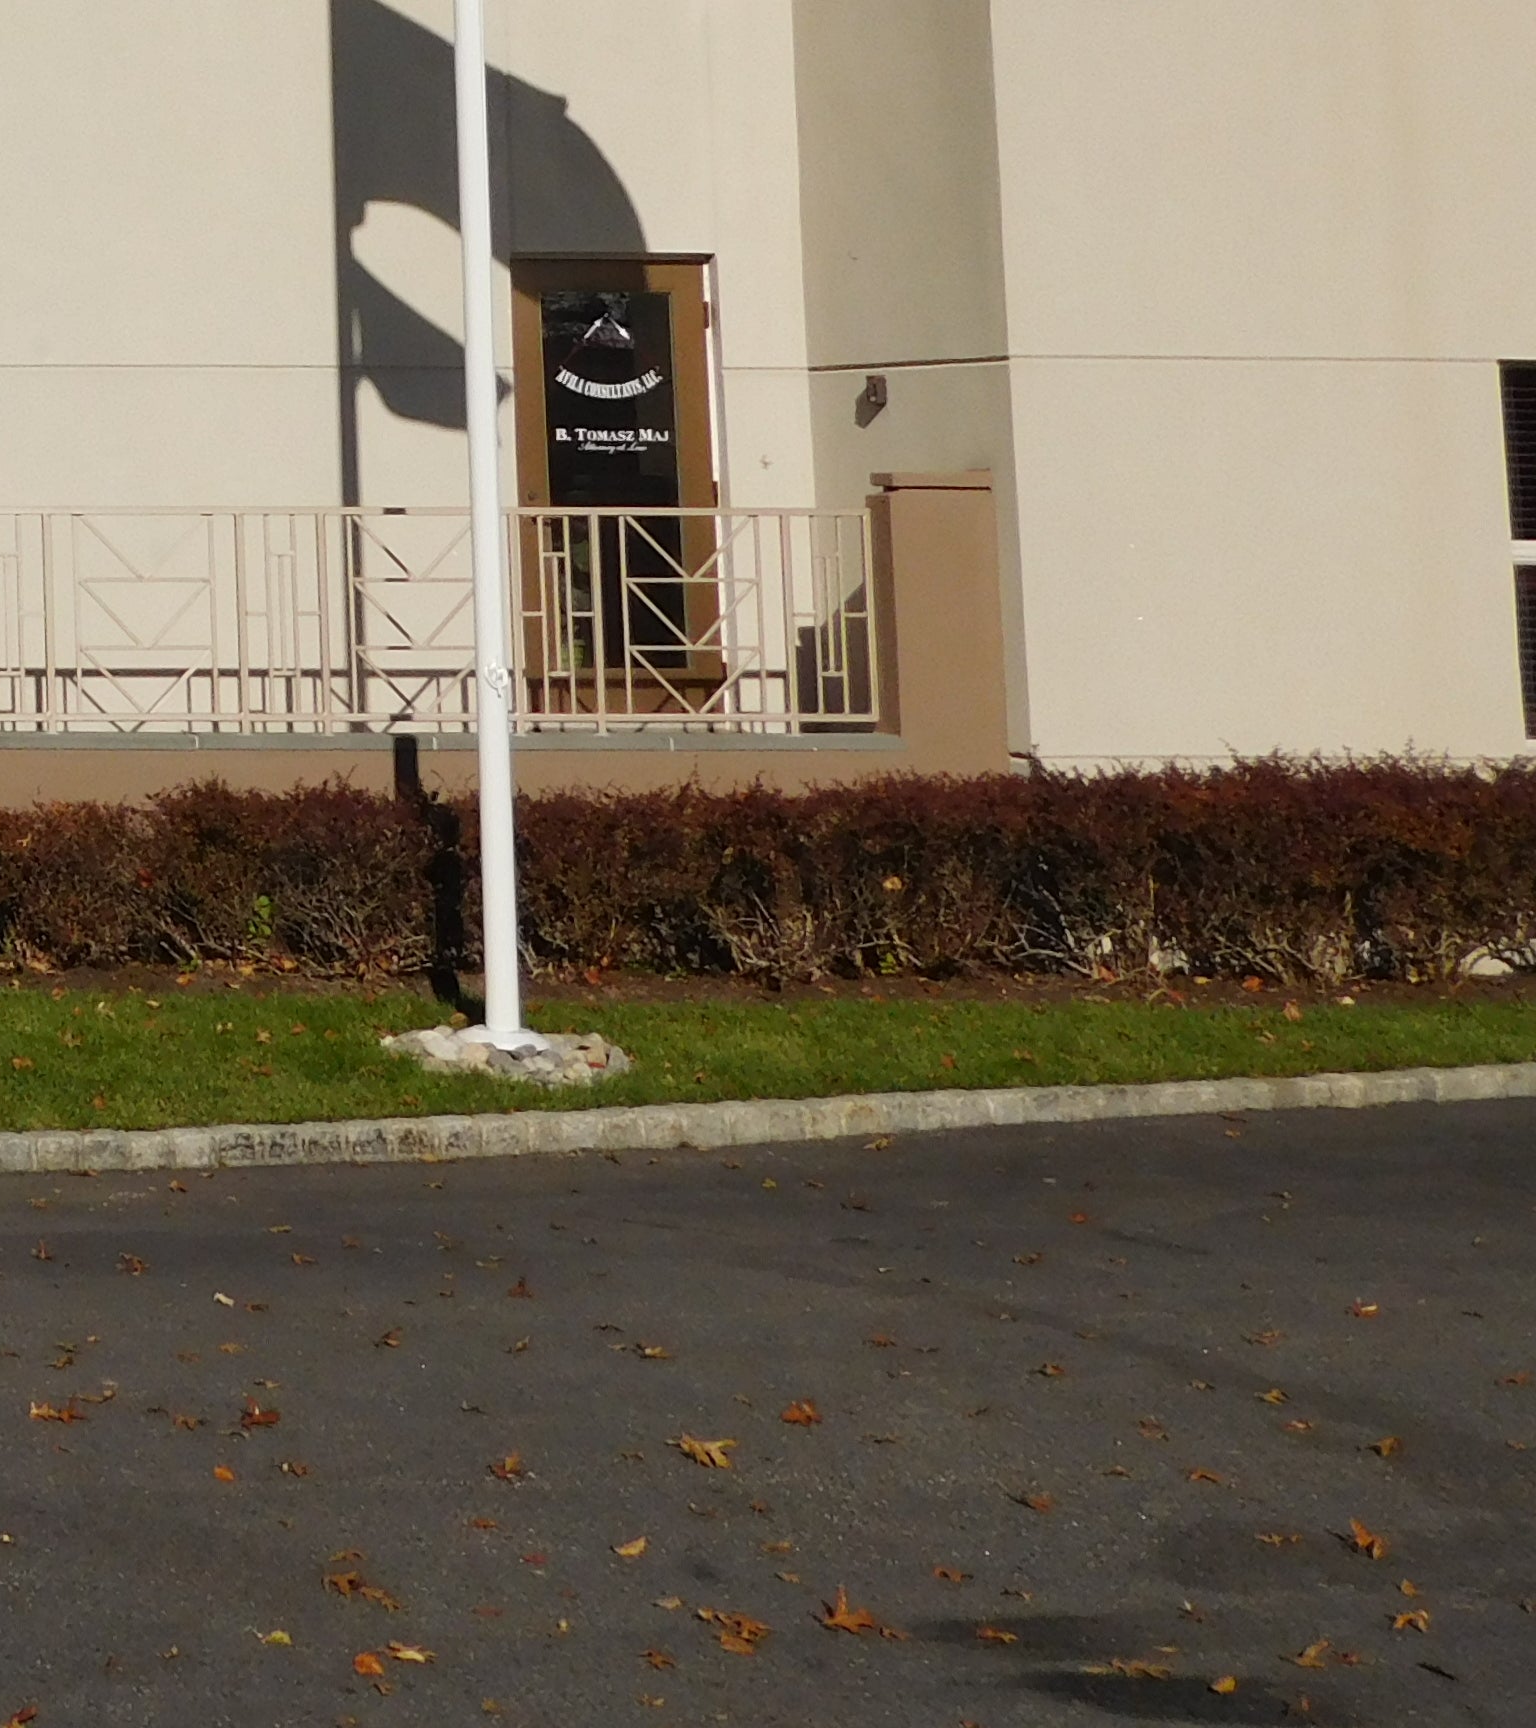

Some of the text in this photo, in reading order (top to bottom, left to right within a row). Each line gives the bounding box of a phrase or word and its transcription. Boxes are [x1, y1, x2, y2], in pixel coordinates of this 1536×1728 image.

[556, 369, 584, 393] AVILA
[556, 428, 669, 441] B. TOMASZ MAJ
